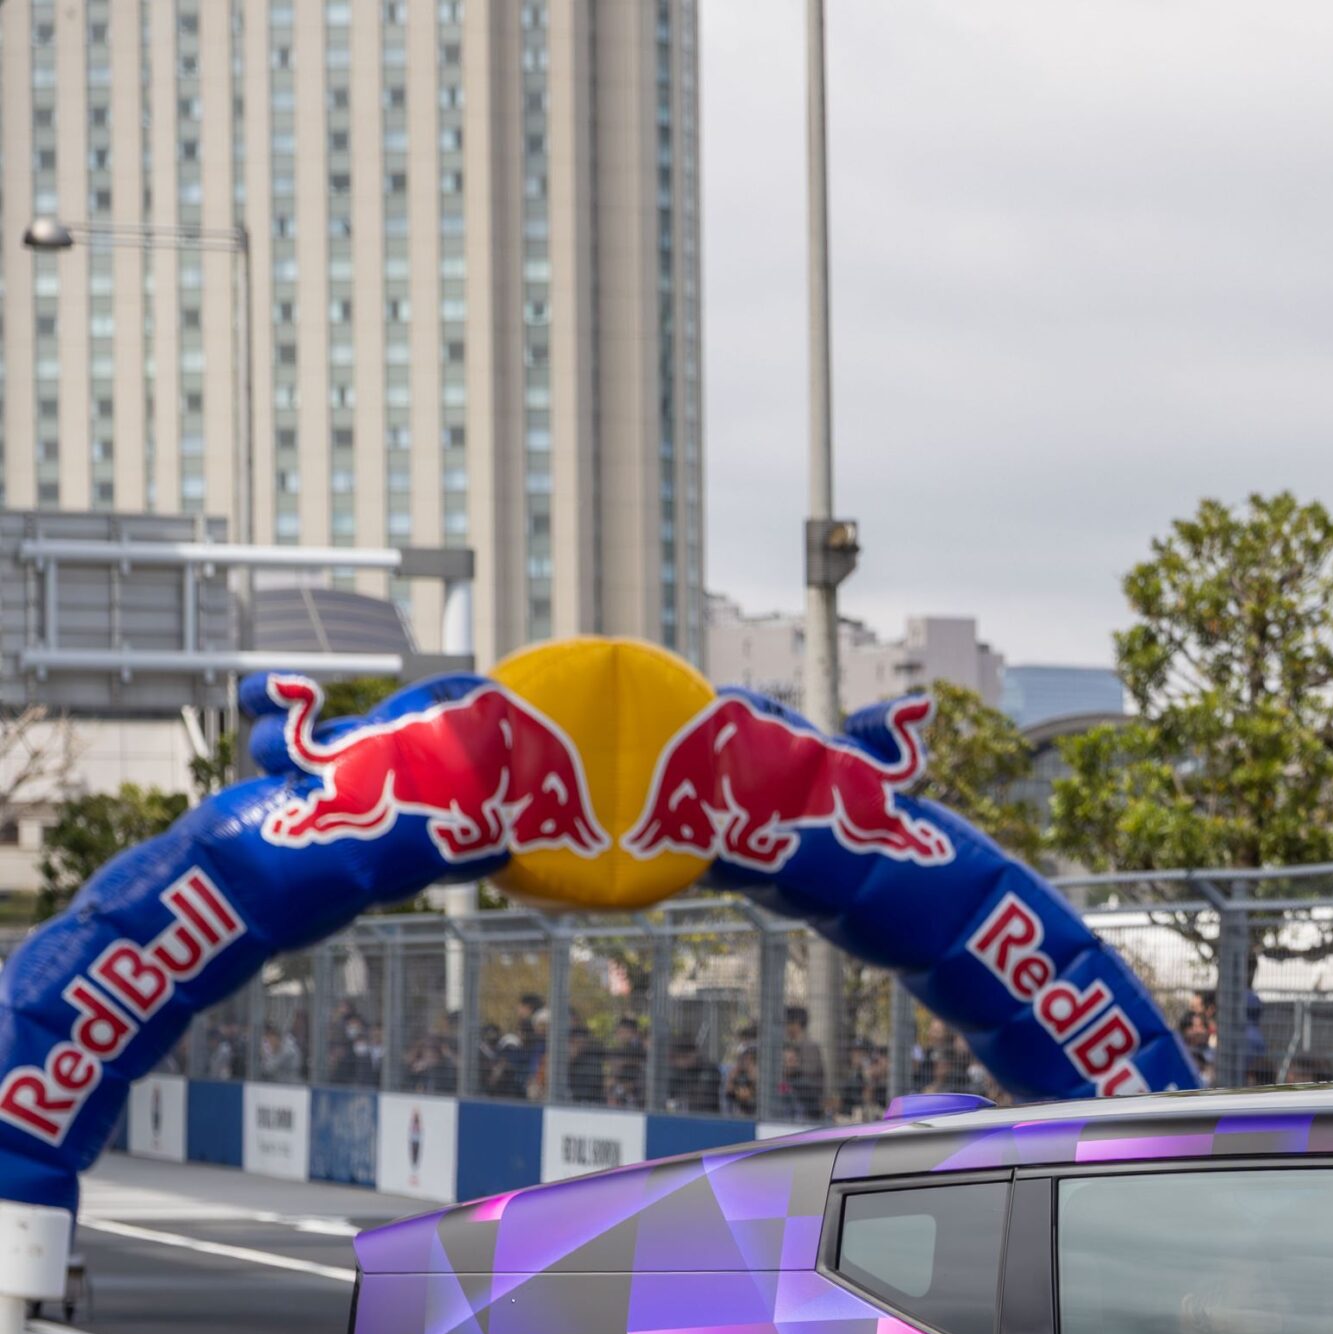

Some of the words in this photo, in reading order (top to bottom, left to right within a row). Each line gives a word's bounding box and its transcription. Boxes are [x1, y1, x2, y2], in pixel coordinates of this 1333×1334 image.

[0, 978, 136, 1143] Red
[92, 870, 242, 1017] Bull
[971, 897, 1110, 1039] Red
